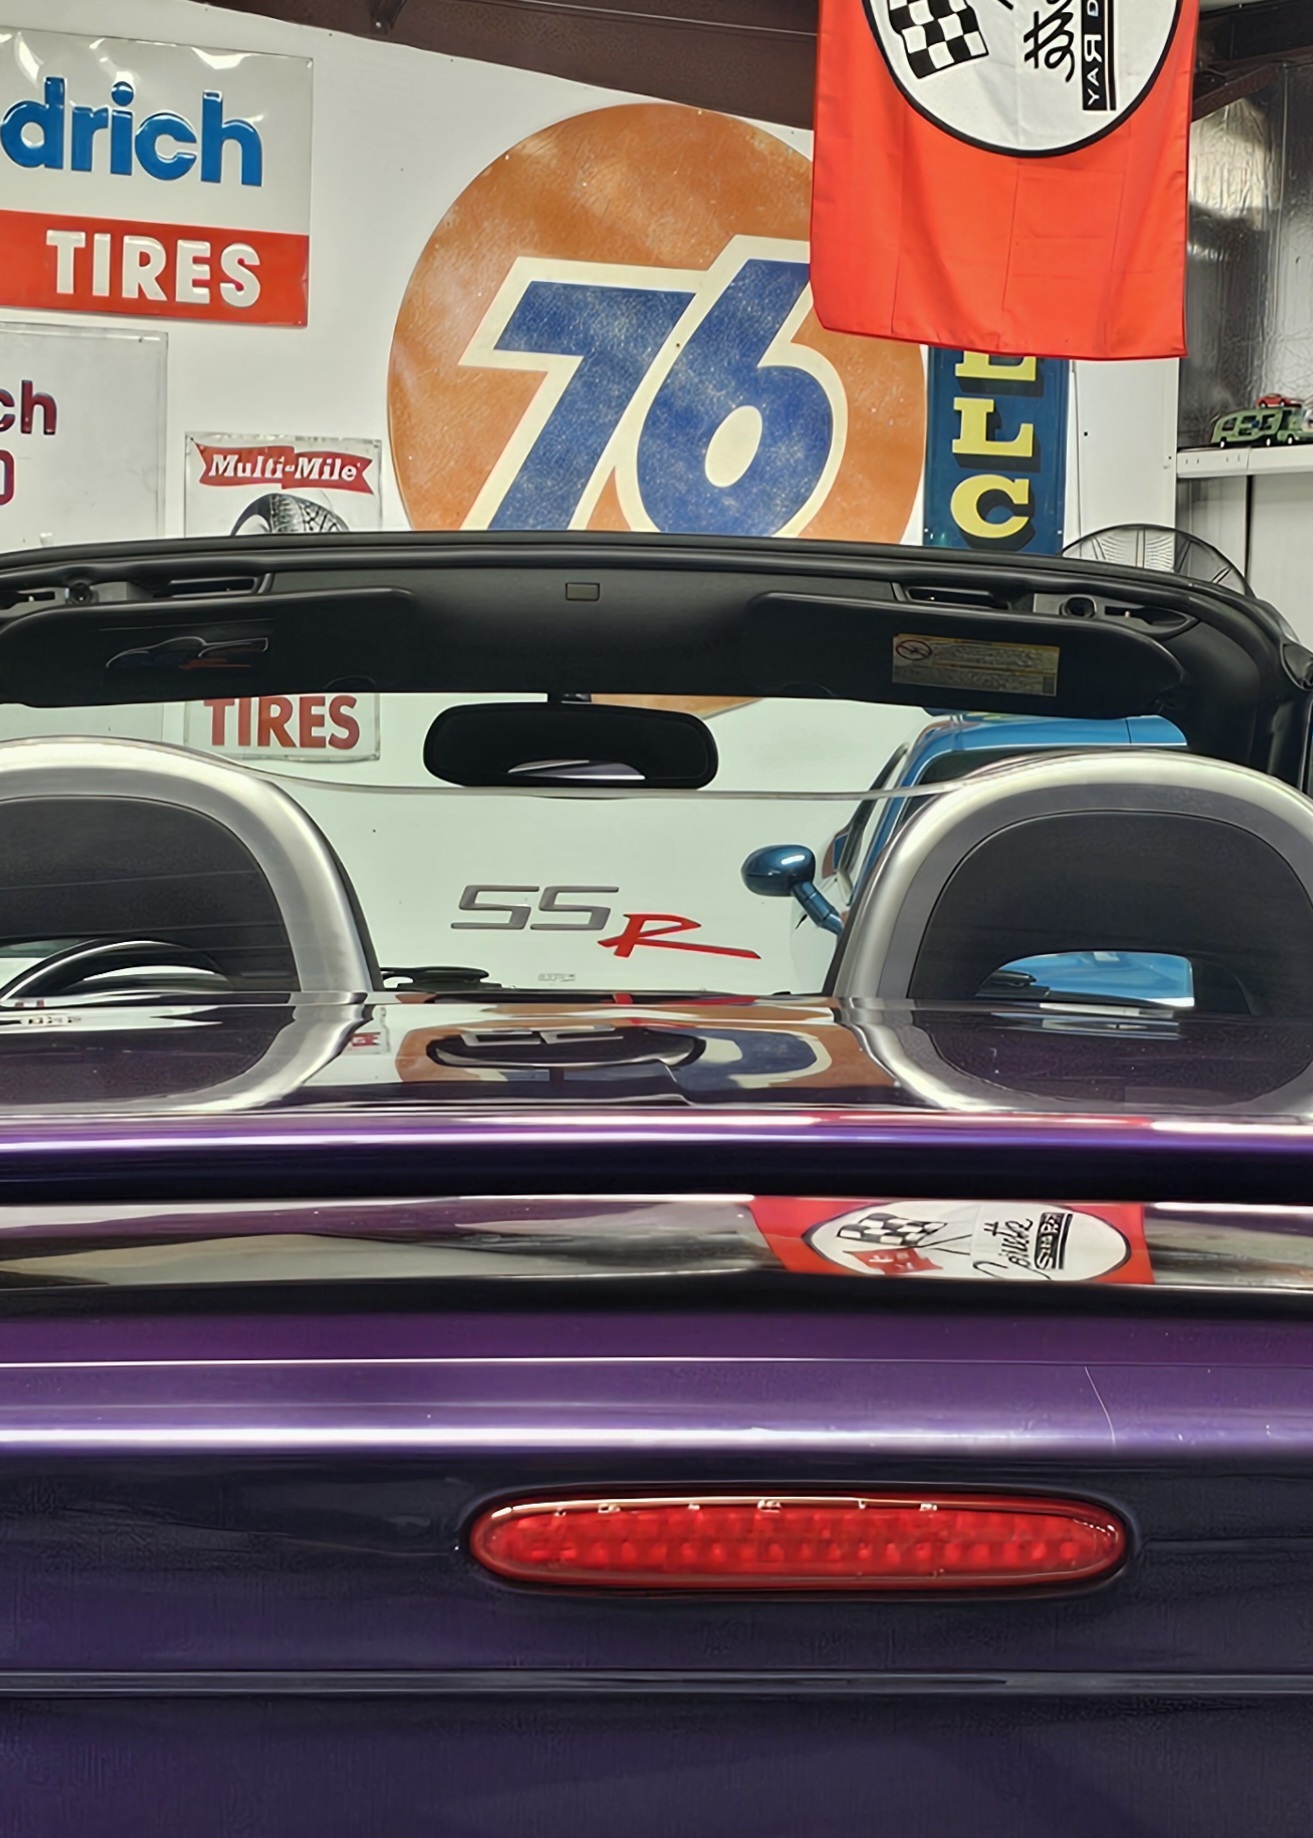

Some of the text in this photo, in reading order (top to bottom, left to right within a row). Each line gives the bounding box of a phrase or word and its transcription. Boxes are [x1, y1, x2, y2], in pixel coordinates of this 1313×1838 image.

[47, 230, 262, 308] TIRES
[458, 235, 849, 536] 76
[208, 454, 358, 481] Multi-Mile
[205, 696, 361, 751] TIRES
